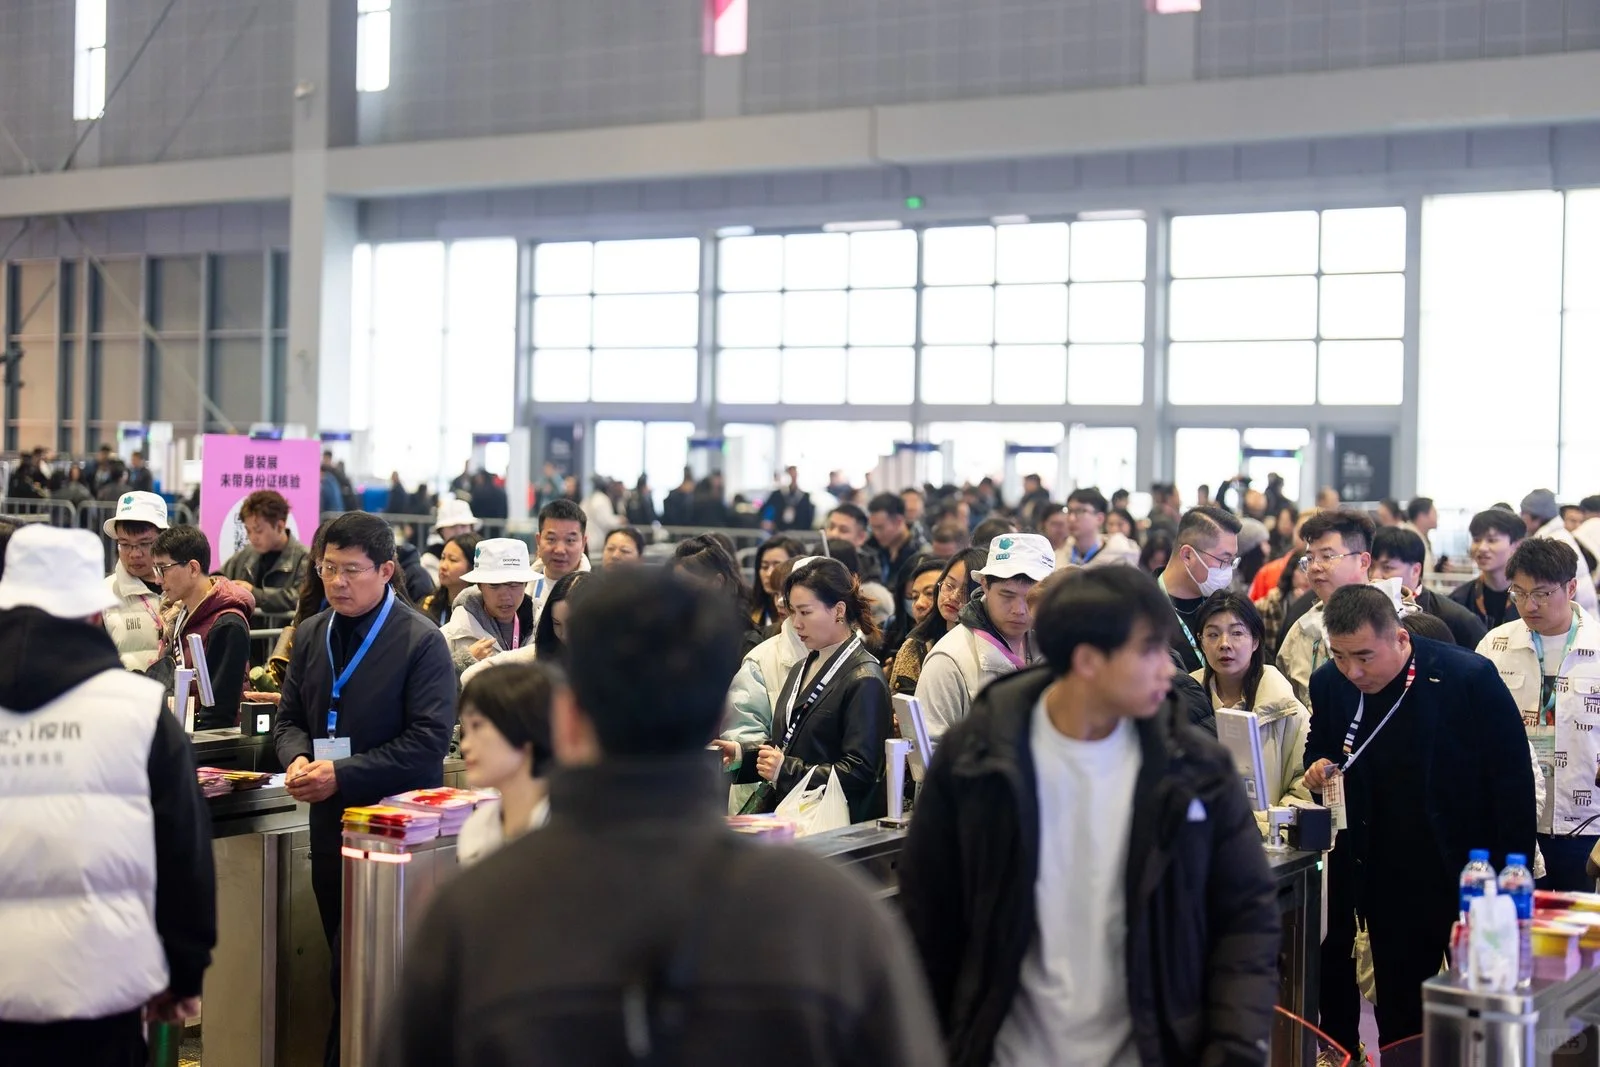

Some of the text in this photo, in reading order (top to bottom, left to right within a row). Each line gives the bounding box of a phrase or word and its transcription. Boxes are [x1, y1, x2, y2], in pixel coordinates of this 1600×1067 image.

[244, 454, 278, 469] 服装展
[220, 473, 300, 488] 未带身份证核验
